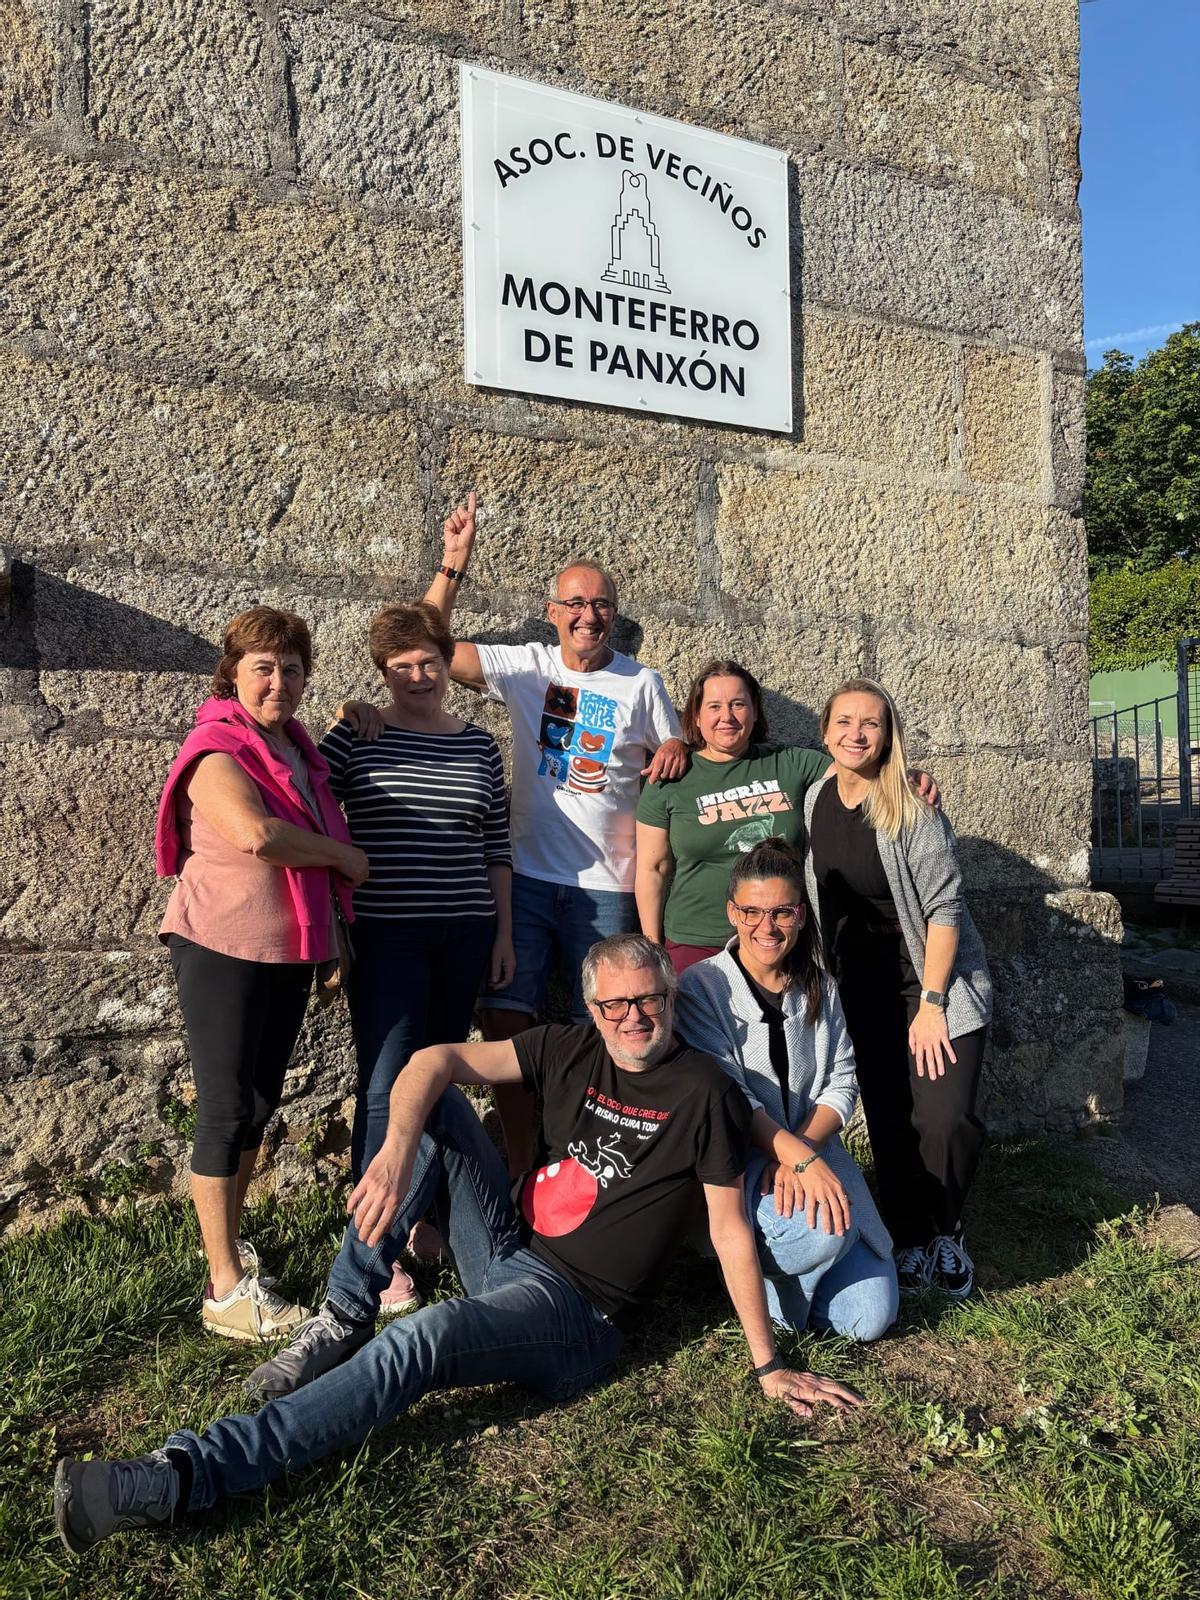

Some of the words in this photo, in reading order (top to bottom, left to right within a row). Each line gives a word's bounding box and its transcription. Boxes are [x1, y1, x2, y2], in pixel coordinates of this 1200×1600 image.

[494, 133, 586, 188] ASOC.
[596, 133, 633, 162] DE
[647, 143, 767, 248] VECIÑOS
[502, 274, 760, 351] MONTEFERRO
[525, 329, 573, 369] DE
[590, 340, 745, 397] PANXÓN
[698, 792, 789, 825] JAZZ
[700, 780, 780, 807] NIGRÁN
[585, 1099, 595, 1112] LA
[620, 1117, 641, 1130] CURA
[597, 1093, 607, 1104] EL
[622, 1105, 638, 1116] QUE
[638, 1108, 657, 1119] CREE
